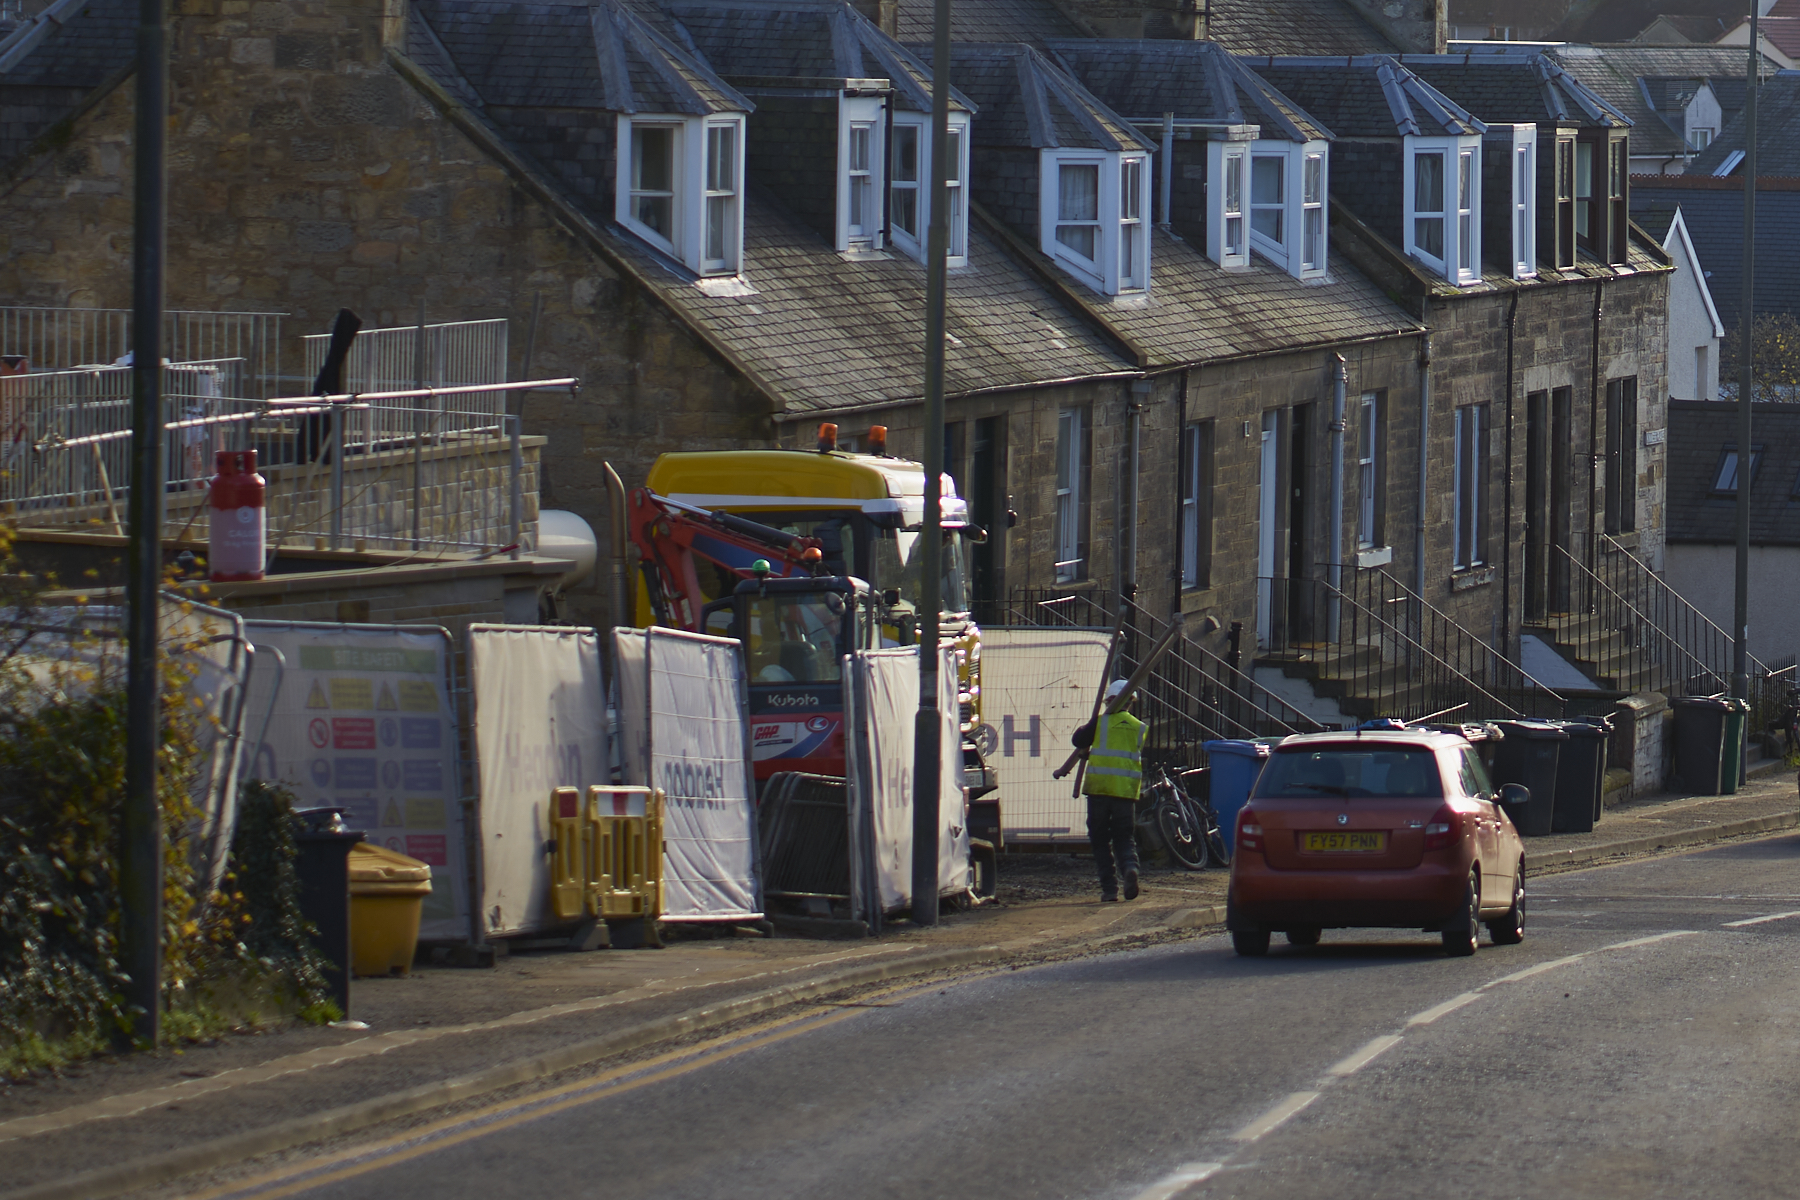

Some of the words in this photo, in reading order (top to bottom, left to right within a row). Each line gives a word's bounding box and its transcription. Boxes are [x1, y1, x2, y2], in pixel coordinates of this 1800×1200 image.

[768, 693, 819, 707] Kubota
[1311, 835, 1346, 847] FY57
[1350, 835, 1378, 847] PNN
